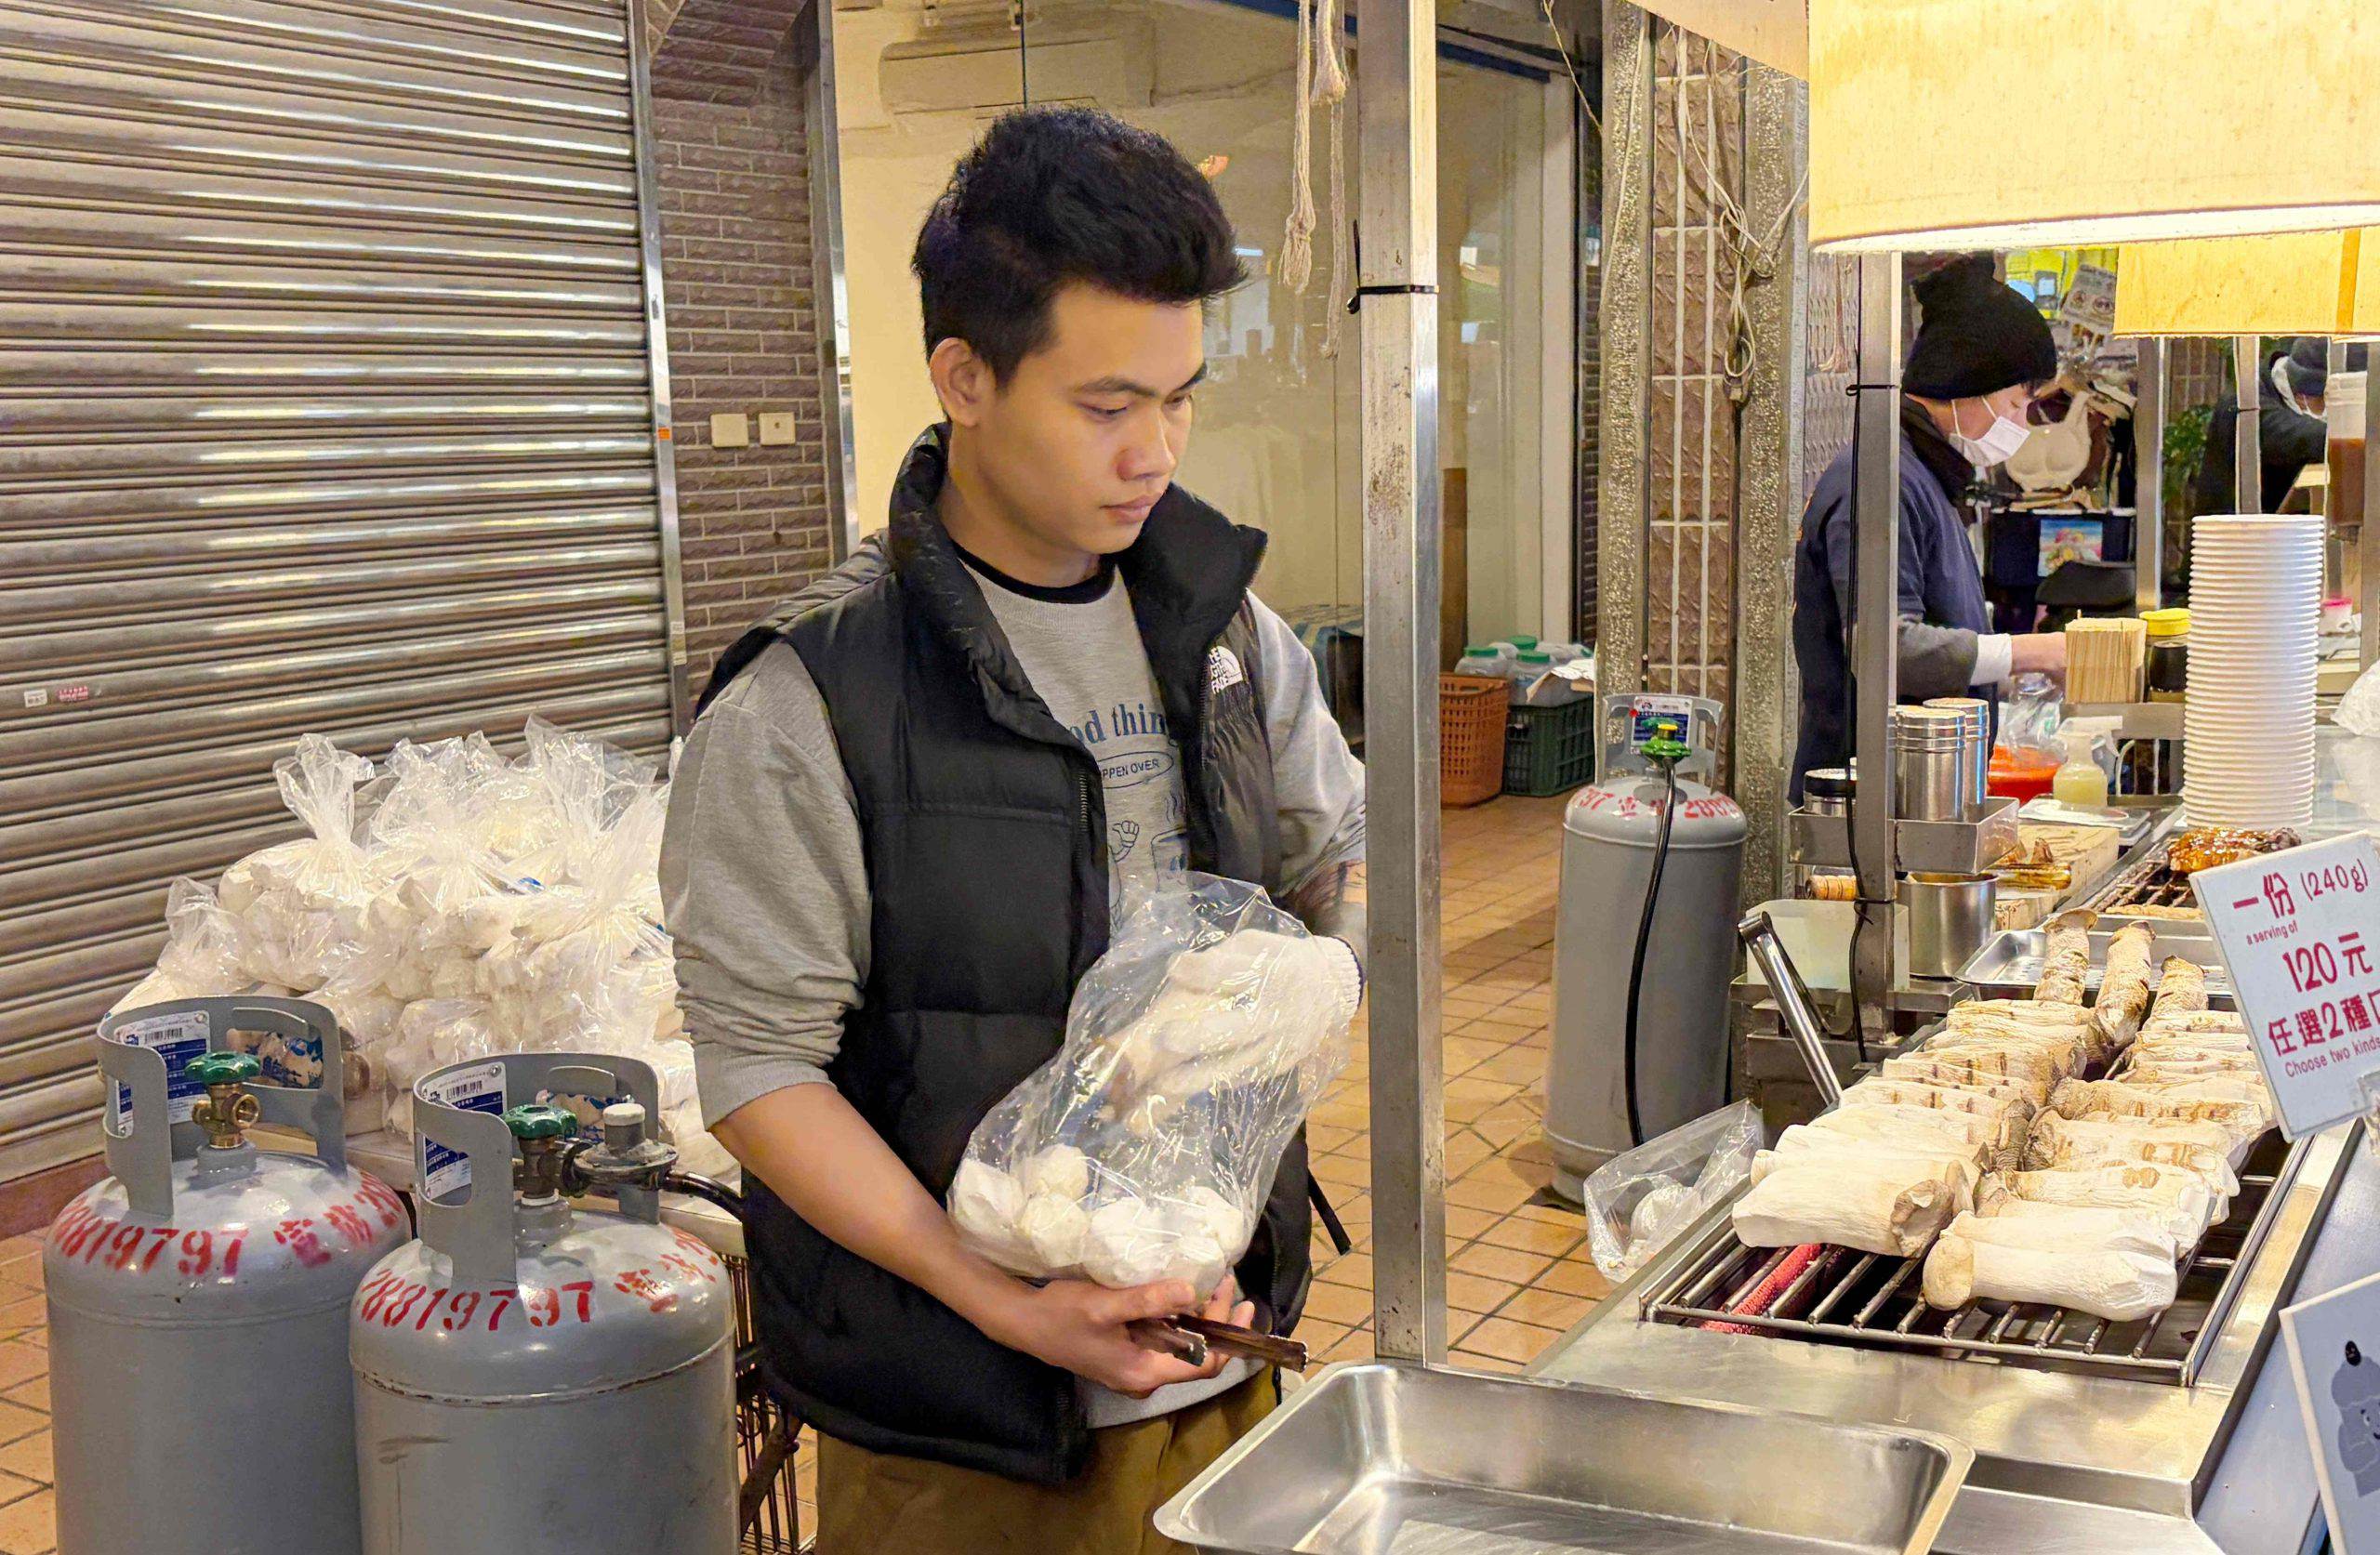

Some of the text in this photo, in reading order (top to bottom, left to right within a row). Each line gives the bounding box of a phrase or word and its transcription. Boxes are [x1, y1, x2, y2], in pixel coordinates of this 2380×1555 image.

[1130, 758, 1159, 773] OVER
[2232, 859, 2369, 919] 一份 (240g)
[2246, 919, 2298, 946] a serving of
[2282, 931, 2373, 994] 120元
[2284, 1055, 2328, 1078] Choose
[2329, 1047, 2350, 1063] two
